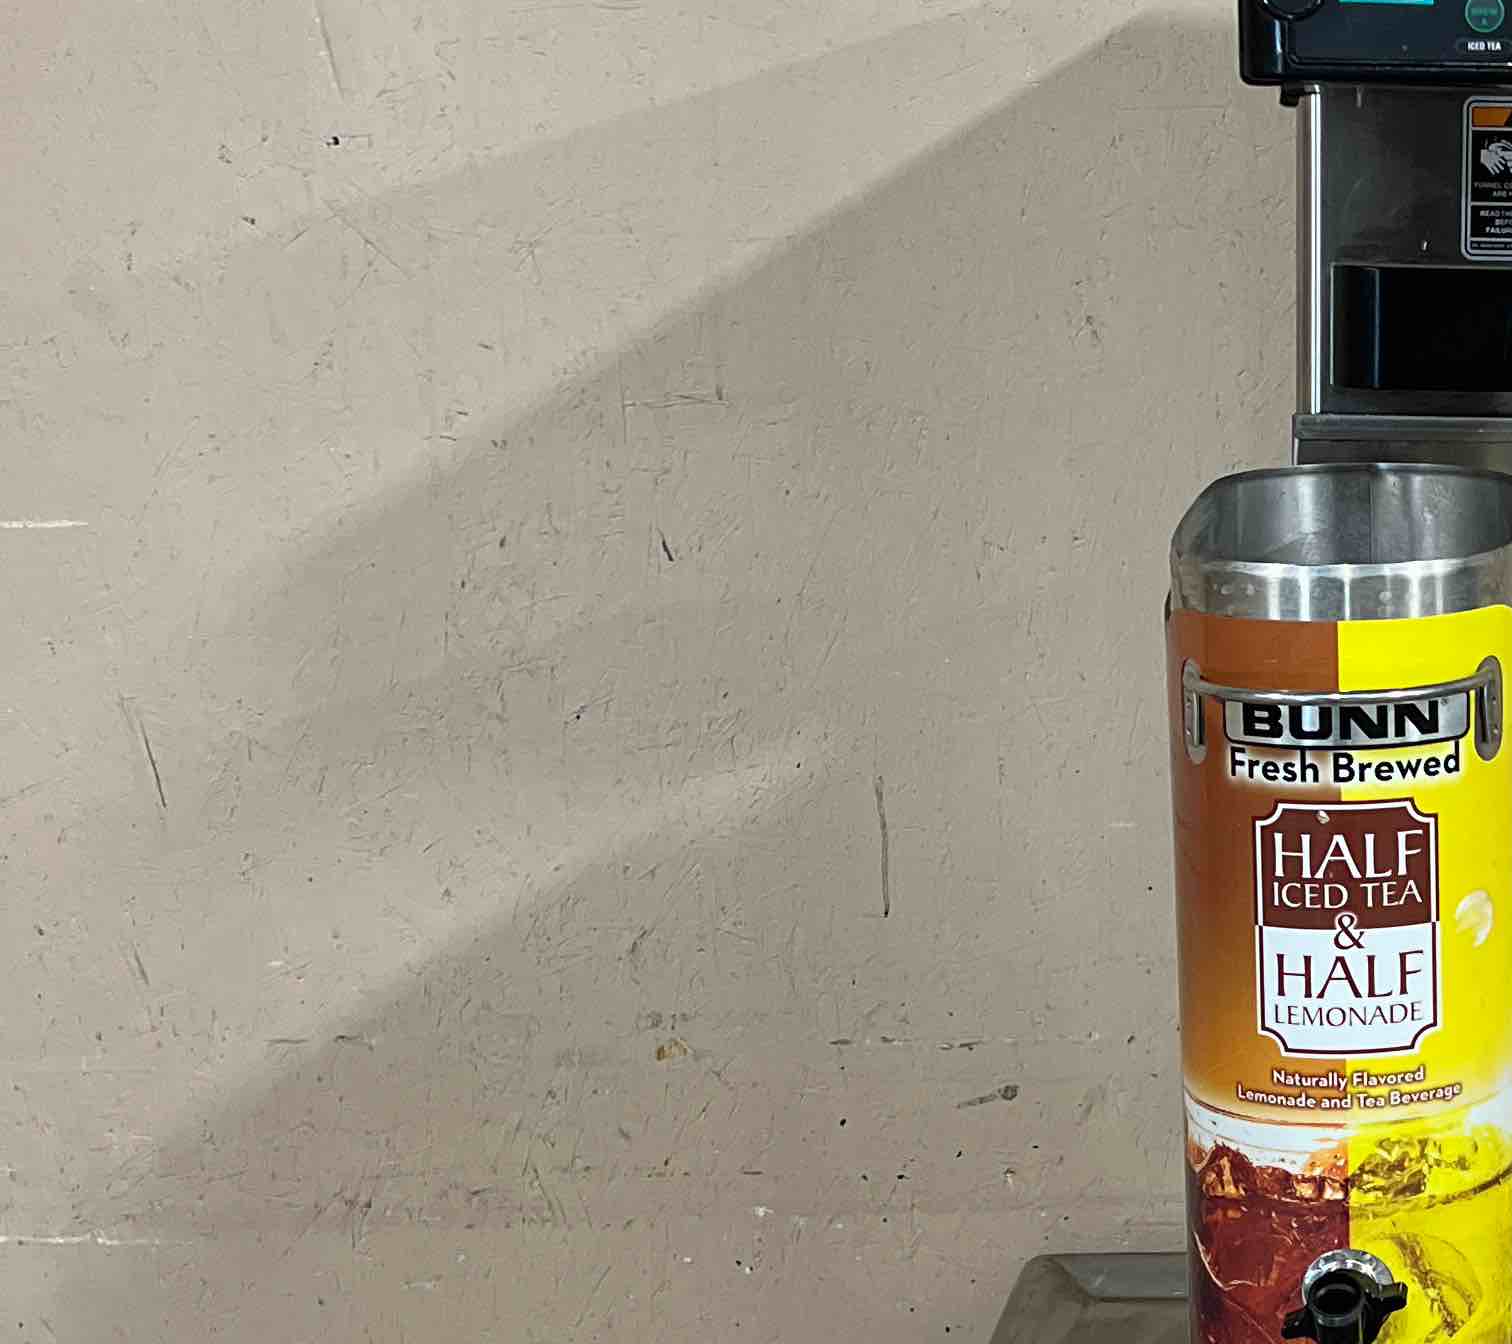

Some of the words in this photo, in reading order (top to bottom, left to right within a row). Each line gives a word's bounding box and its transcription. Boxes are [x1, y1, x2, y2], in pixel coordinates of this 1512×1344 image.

[1467, 41, 1486, 51] ICED
[1487, 42, 1502, 52] TEA
[1242, 700, 1439, 740] BUNN
[1230, 746, 1319, 783] Fresh
[1333, 739, 1460, 783] Brewed
[1273, 829, 1423, 879] HALF
[1273, 881, 1349, 909] ICED
[1360, 879, 1422, 907] TEA
[1333, 913, 1365, 950] &
[1276, 950, 1424, 998] HALF
[1274, 1001, 1424, 1026] LEMONADE
[1236, 1084, 1317, 1108] Lemonade
[1321, 1093, 1350, 1108] and
[1356, 1094, 1385, 1108] Tea
[1390, 1082, 1461, 1105] Beverage
[1272, 1068, 1348, 1091] Naturally
[1352, 1066, 1425, 1088] Flavored
